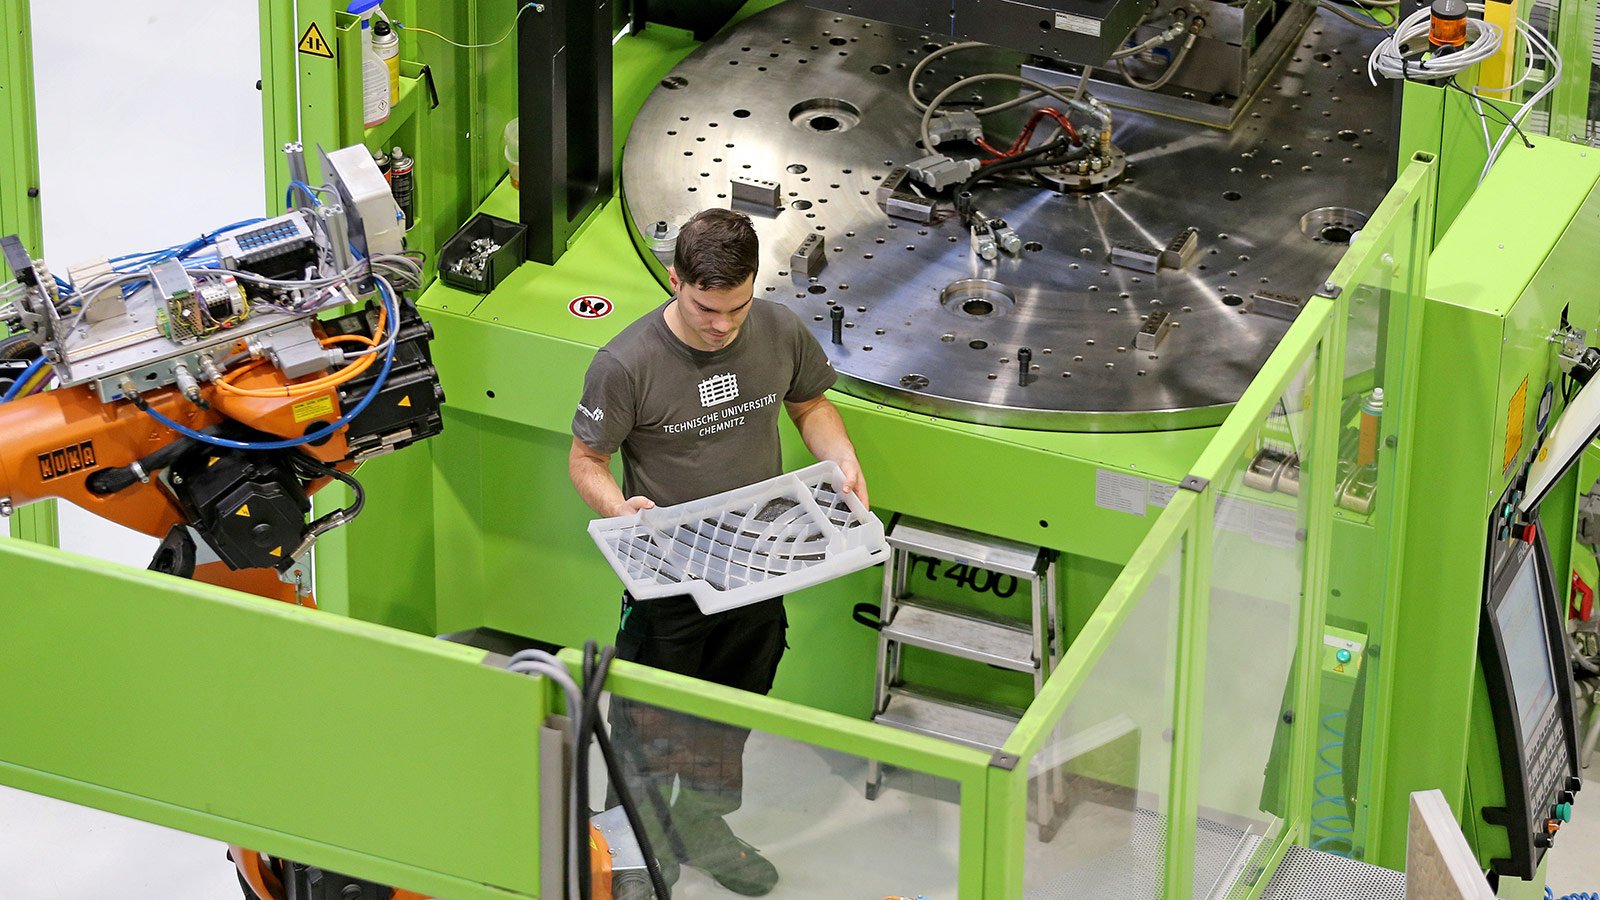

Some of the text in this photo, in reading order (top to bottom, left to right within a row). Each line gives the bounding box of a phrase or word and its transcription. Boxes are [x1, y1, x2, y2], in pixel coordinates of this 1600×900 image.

[663, 393, 777, 433] TECHNISCHE UNIVERSITÄT
[699, 416, 745, 436] CHEMNITZ
[39, 444, 97, 480] KUKA
[944, 563, 1018, 598] 400
